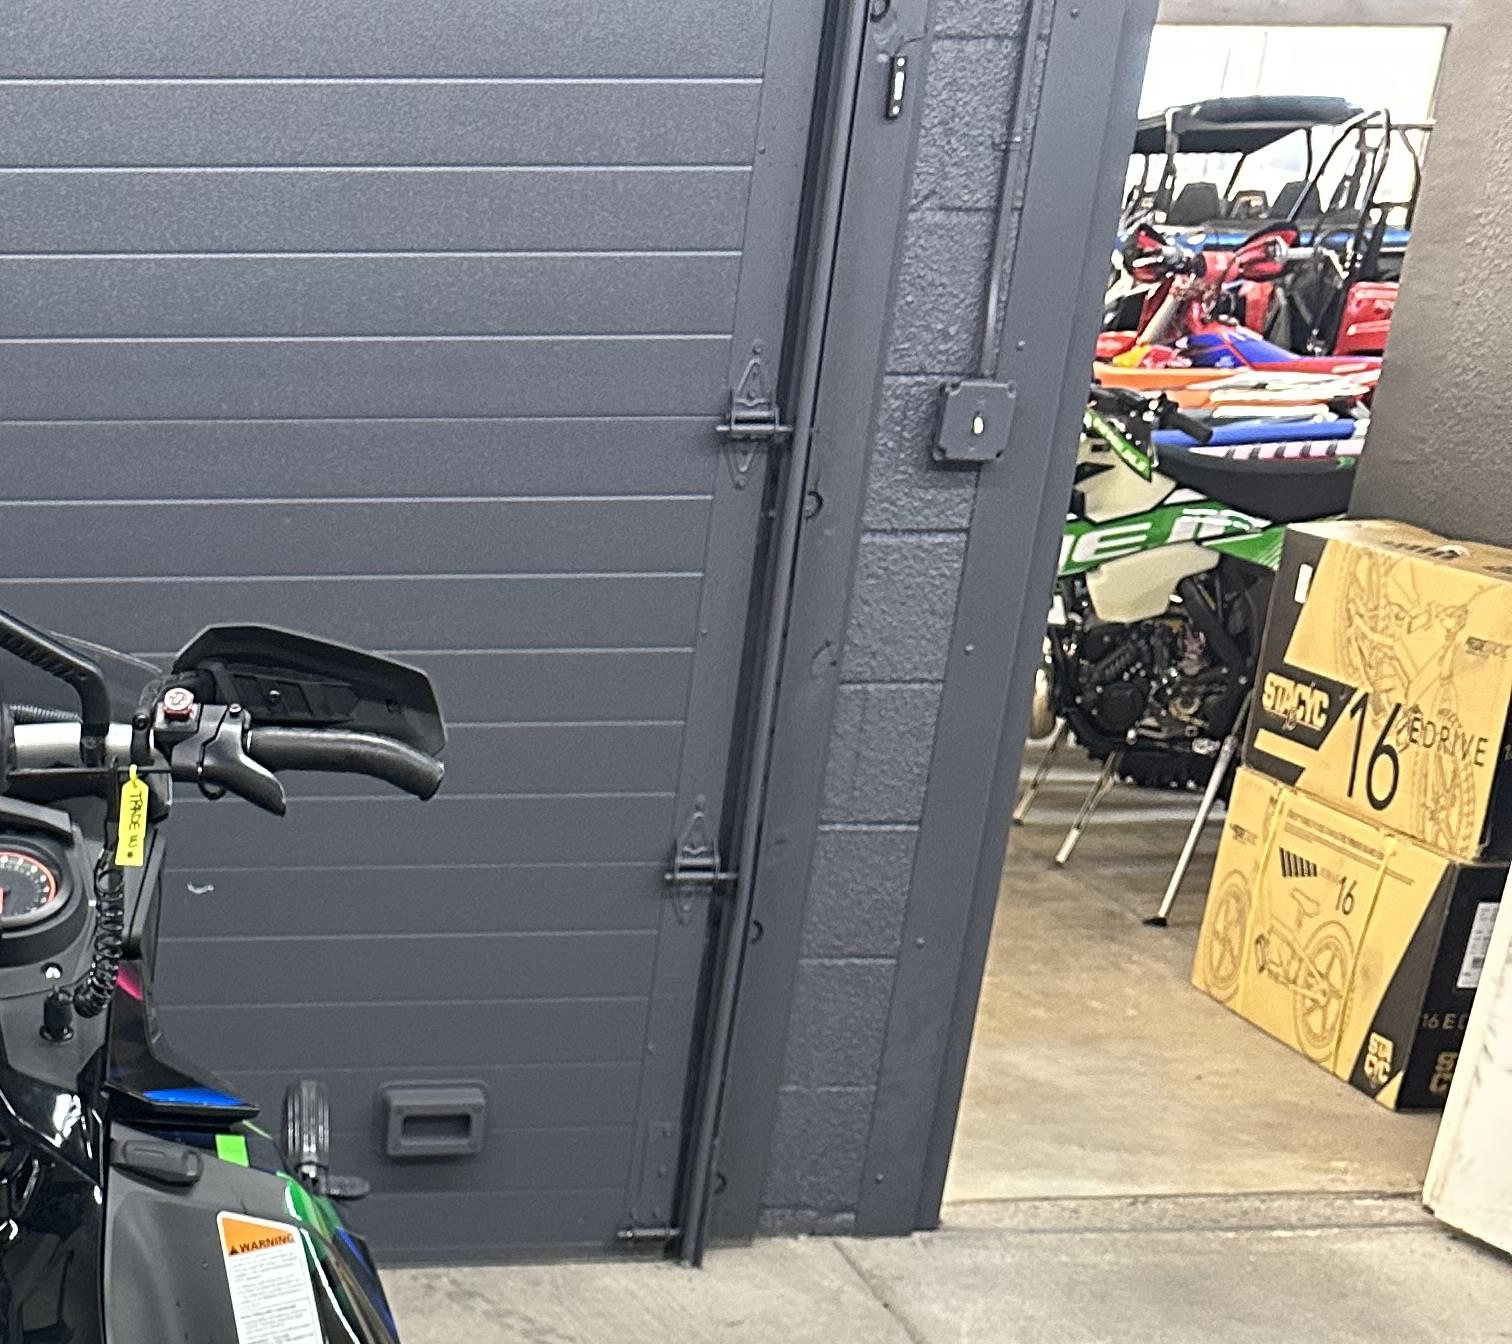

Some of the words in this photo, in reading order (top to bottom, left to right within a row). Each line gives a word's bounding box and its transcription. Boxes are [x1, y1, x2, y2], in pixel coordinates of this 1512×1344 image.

[1262, 672, 1330, 731] STACYC
[1349, 692, 1402, 811] 16
[1409, 716, 1489, 767] EDRIVE
[1335, 875, 1358, 916] 16
[239, 1233, 295, 1254] WARNING
